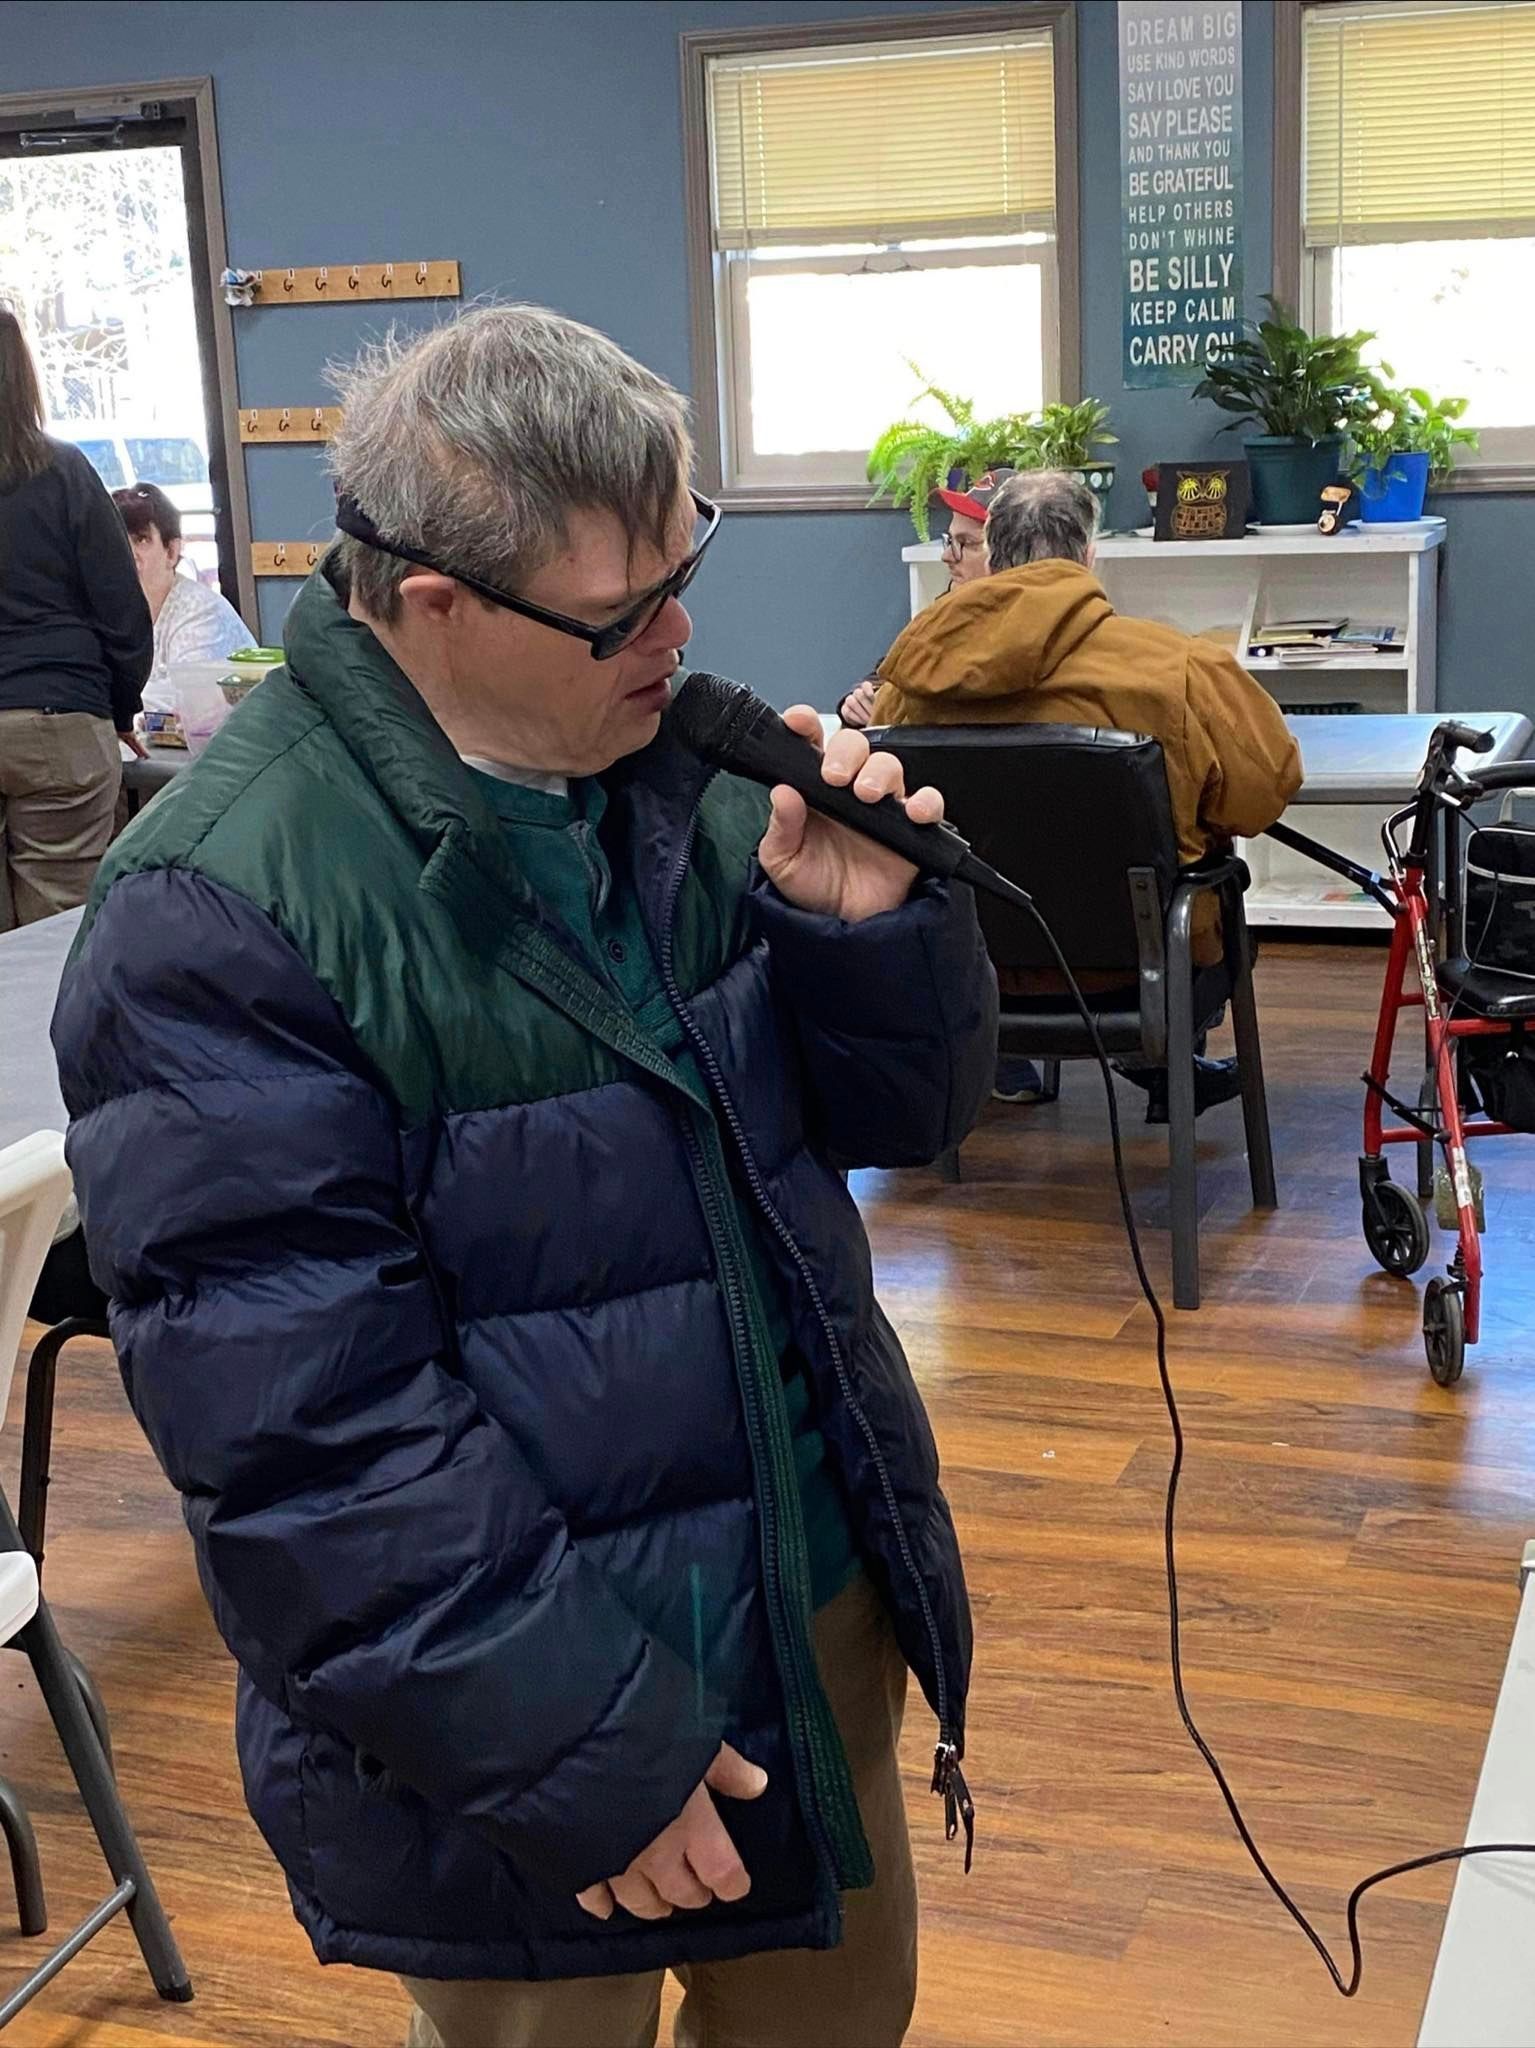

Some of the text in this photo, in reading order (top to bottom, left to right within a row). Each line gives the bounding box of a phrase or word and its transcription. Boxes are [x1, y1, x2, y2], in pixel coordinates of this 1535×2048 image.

[1127, 12, 1236, 46] DREAM BIG
[1127, 47, 1235, 73] USE KIND WORDS
[1128, 75, 1234, 103] SAY I LOVE YOU
[1128, 105, 1232, 139] SAY PLEASE
[1128, 139, 1230, 164] AND THANK YOU
[1129, 165, 1234, 196] BE GRATEFUL
[1129, 200, 1233, 224] HELP OTHERS
[1129, 227, 1235, 250] DON'T WHINE
[1130, 253, 1234, 292] BE SILLY
[1130, 297, 1235, 326] KEEP CALM
[1130, 331, 1234, 366] CARRY ON
